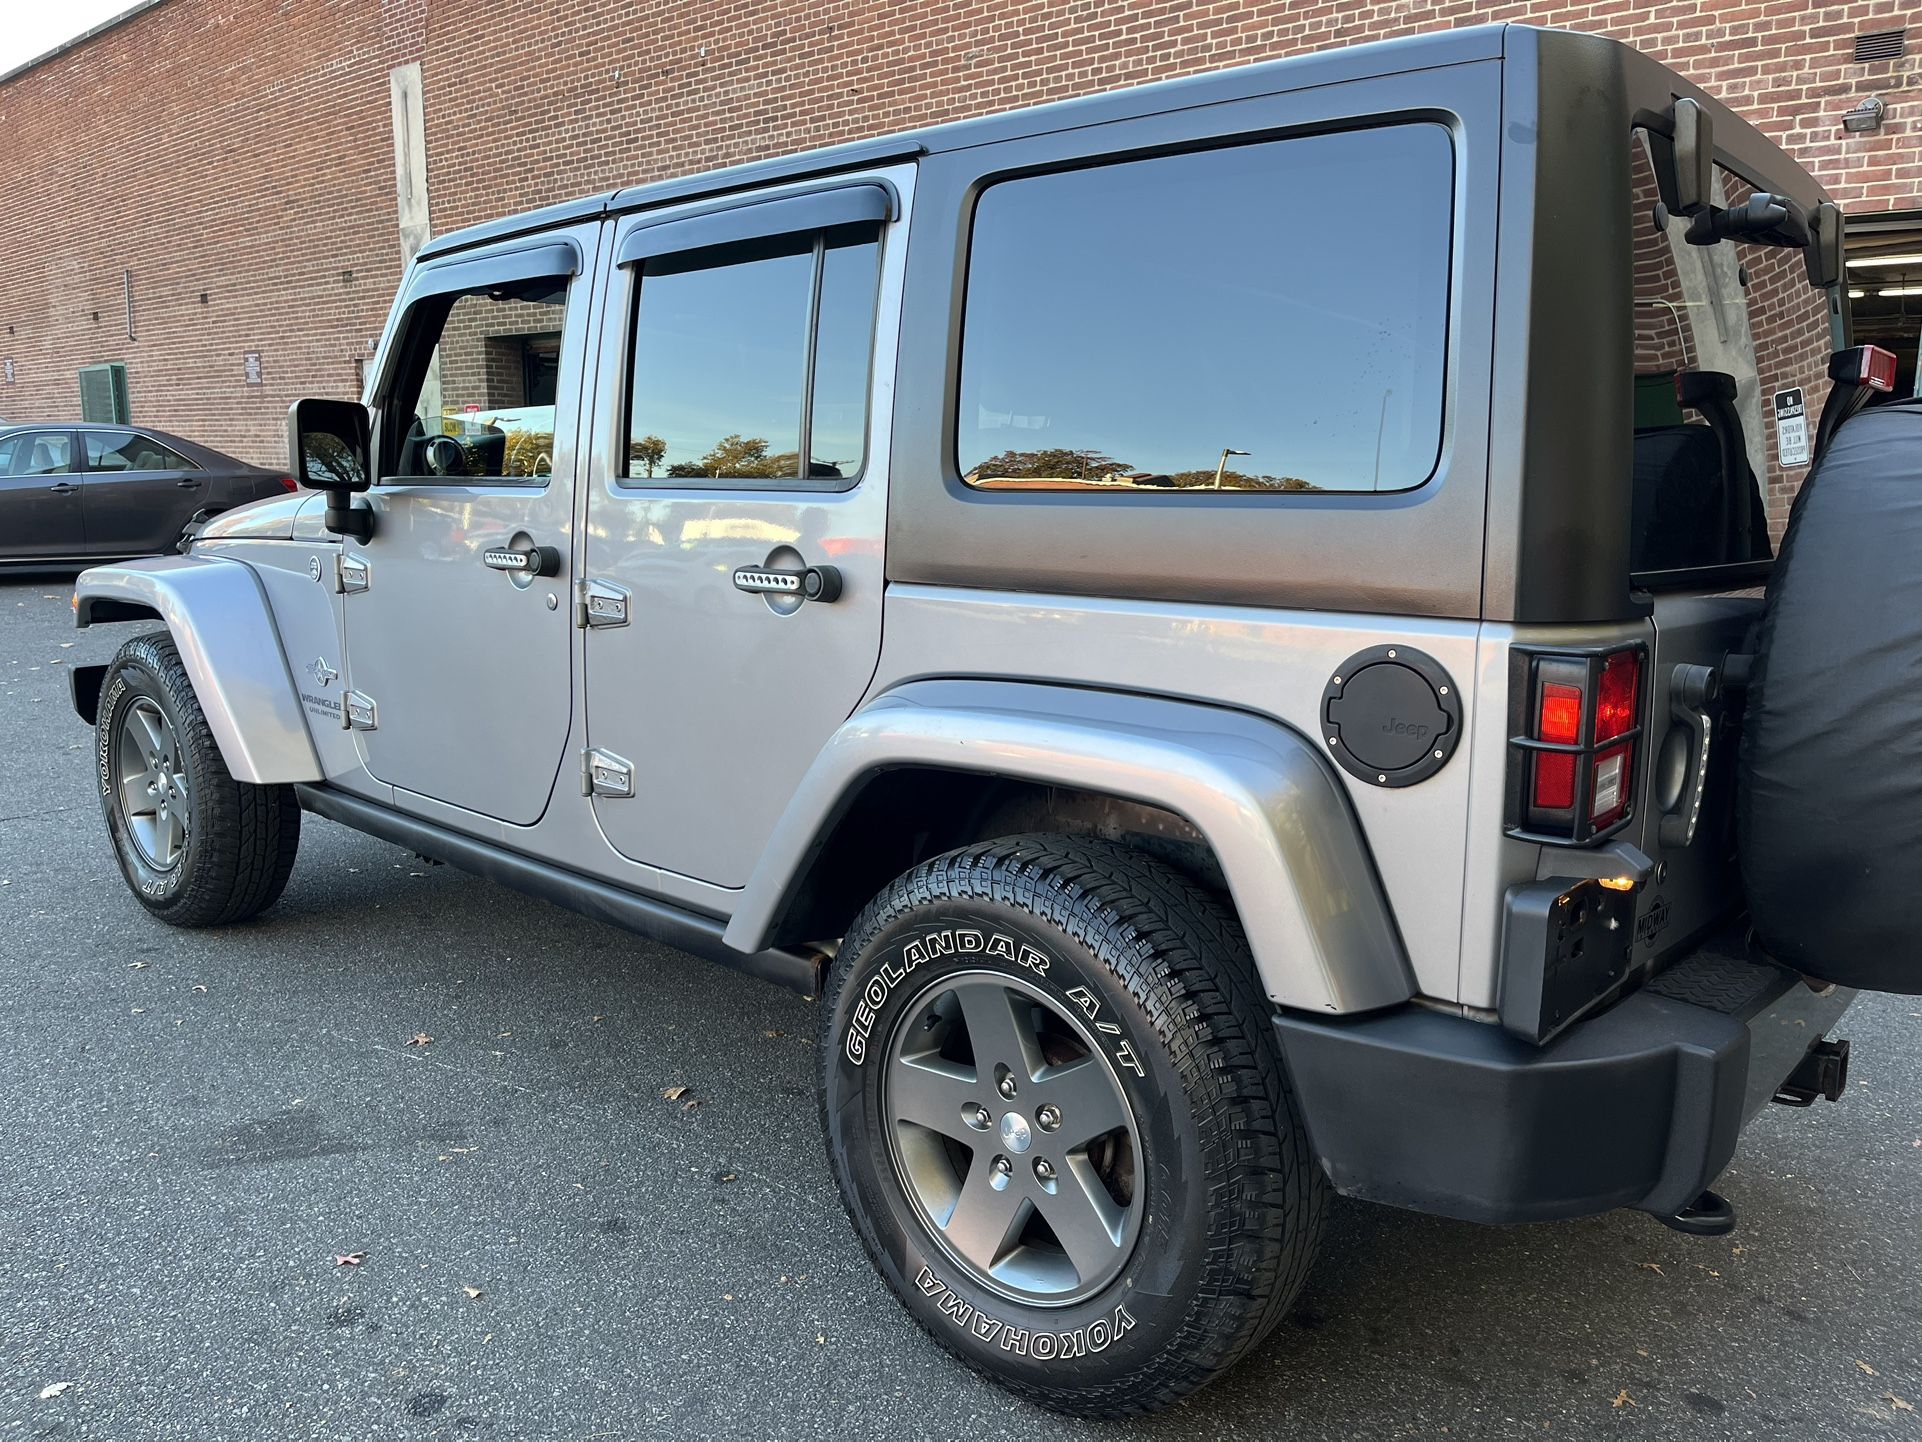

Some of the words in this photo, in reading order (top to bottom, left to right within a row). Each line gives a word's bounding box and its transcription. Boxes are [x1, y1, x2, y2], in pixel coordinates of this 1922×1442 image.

[301, 693, 341, 711] WRANGLE
[1382, 717, 1429, 740] Jeep
[100, 678, 126, 796] YOKOHAMA
[1638, 904, 1671, 934] MIDWAY
[846, 928, 1051, 1066] GEOLANDAR
[1066, 985, 1146, 1078] A/T
[915, 1265, 1137, 1360] YOKOHAMA
